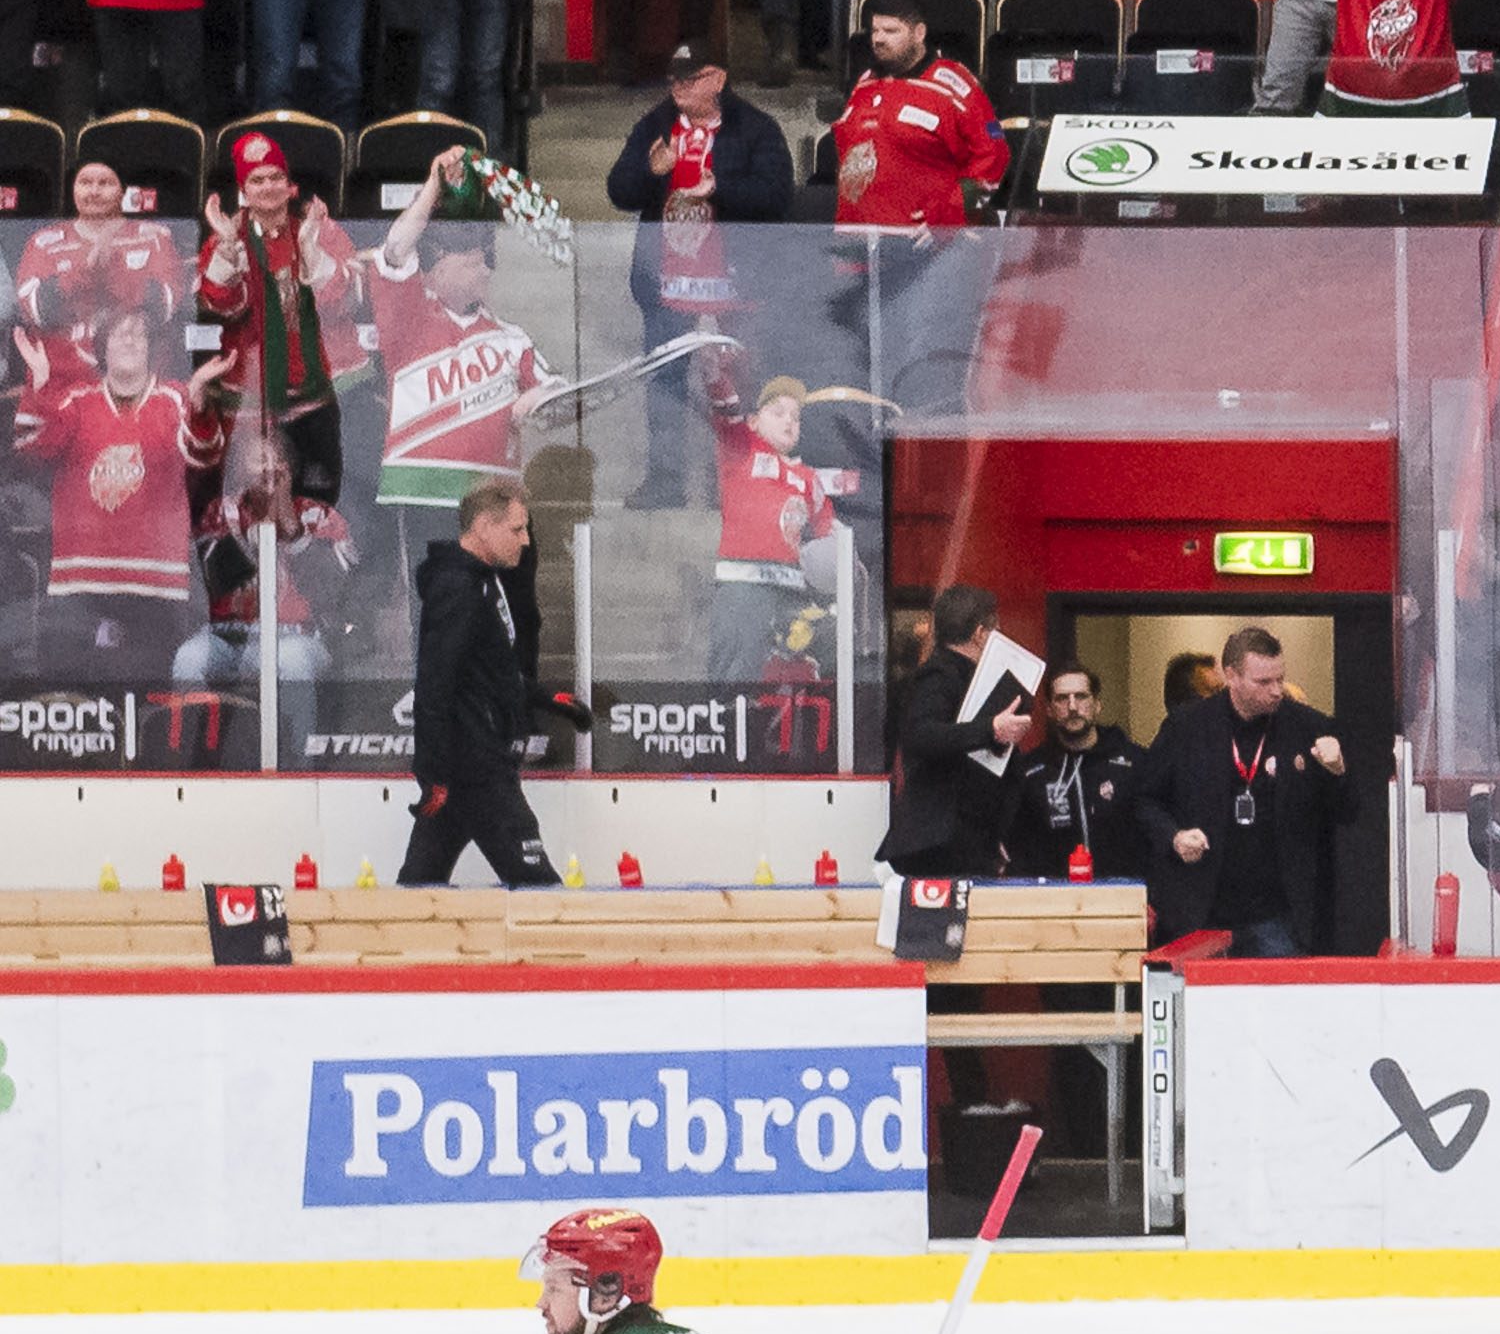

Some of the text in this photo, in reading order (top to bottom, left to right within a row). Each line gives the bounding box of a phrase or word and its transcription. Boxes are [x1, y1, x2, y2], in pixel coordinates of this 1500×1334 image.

[1371, 9, 1418, 35] MODO
[1189, 149, 1471, 173] Skodasätet
[610, 699, 727, 740] sport
[33, 732, 115, 758] ringen
[304, 734, 415, 755] STICK
[643, 733, 727, 758] ringen
[344, 1065, 927, 1179] Polarbröd
